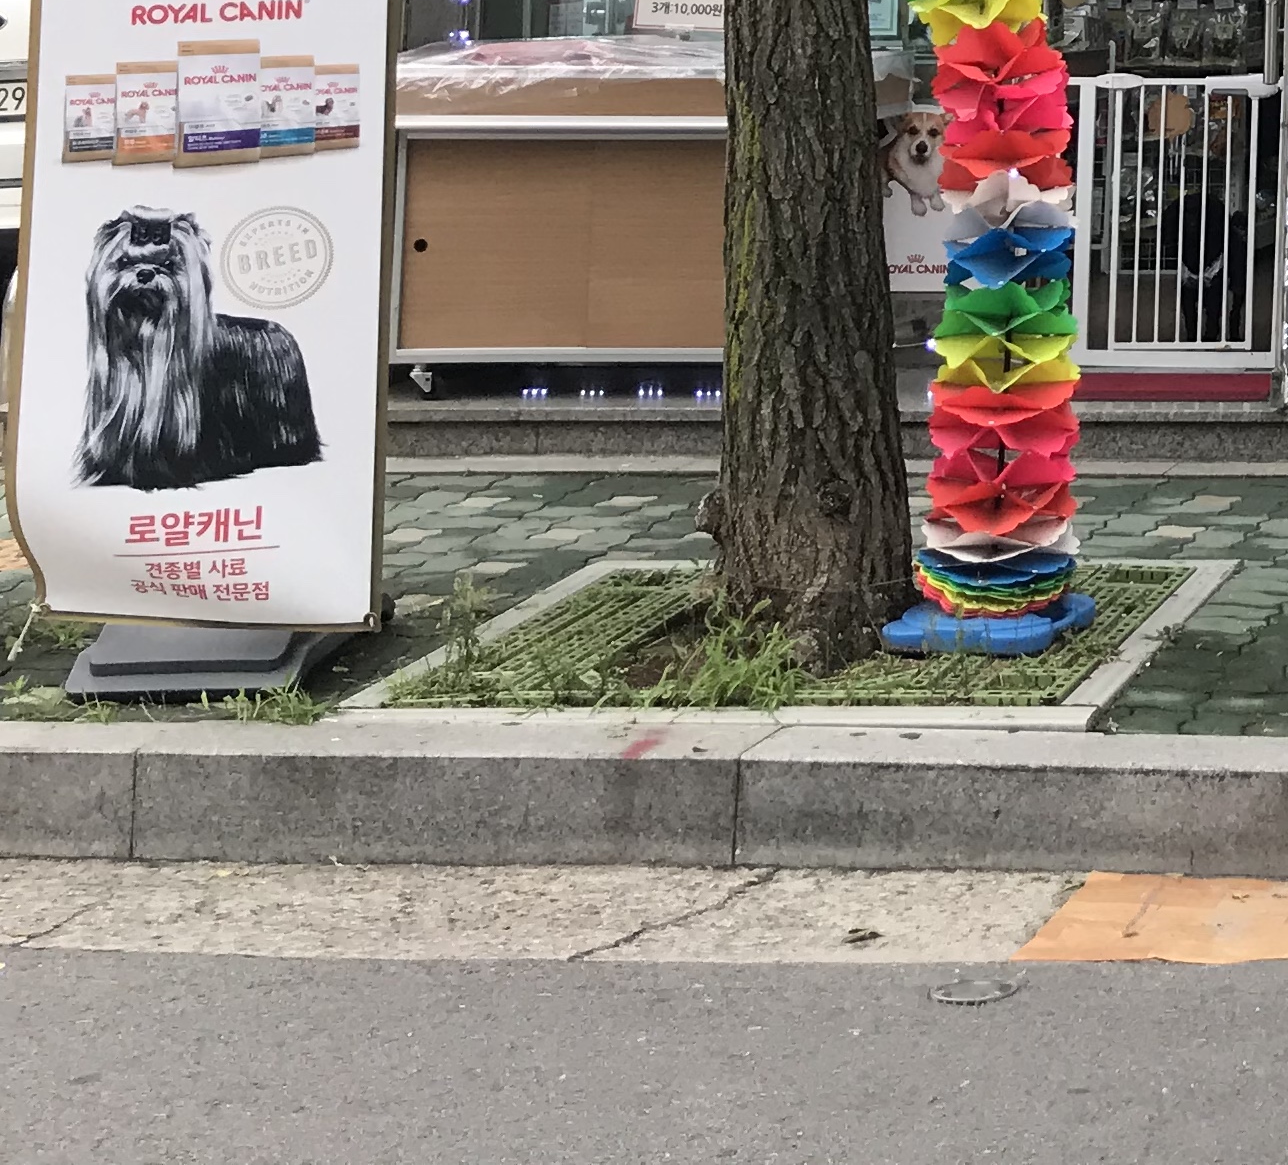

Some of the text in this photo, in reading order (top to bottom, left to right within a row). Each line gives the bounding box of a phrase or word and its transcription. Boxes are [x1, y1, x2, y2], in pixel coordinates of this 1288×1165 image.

[131, 0, 303, 26] ROYAL CANIN
[184, 73, 257, 85] ROYAL CANIN
[121, 90, 149, 98] ROYAL
[261, 84, 282, 92] OYAL
[315, 88, 333, 96] OYAL
[237, 238, 318, 275] BREED
[886, 264, 915, 275] OYAL
[125, 505, 263, 547] 로얄캐닌
[145, 558, 248, 581] 견종별 사료
[130, 579, 270, 602] 공식 판매 전문점
